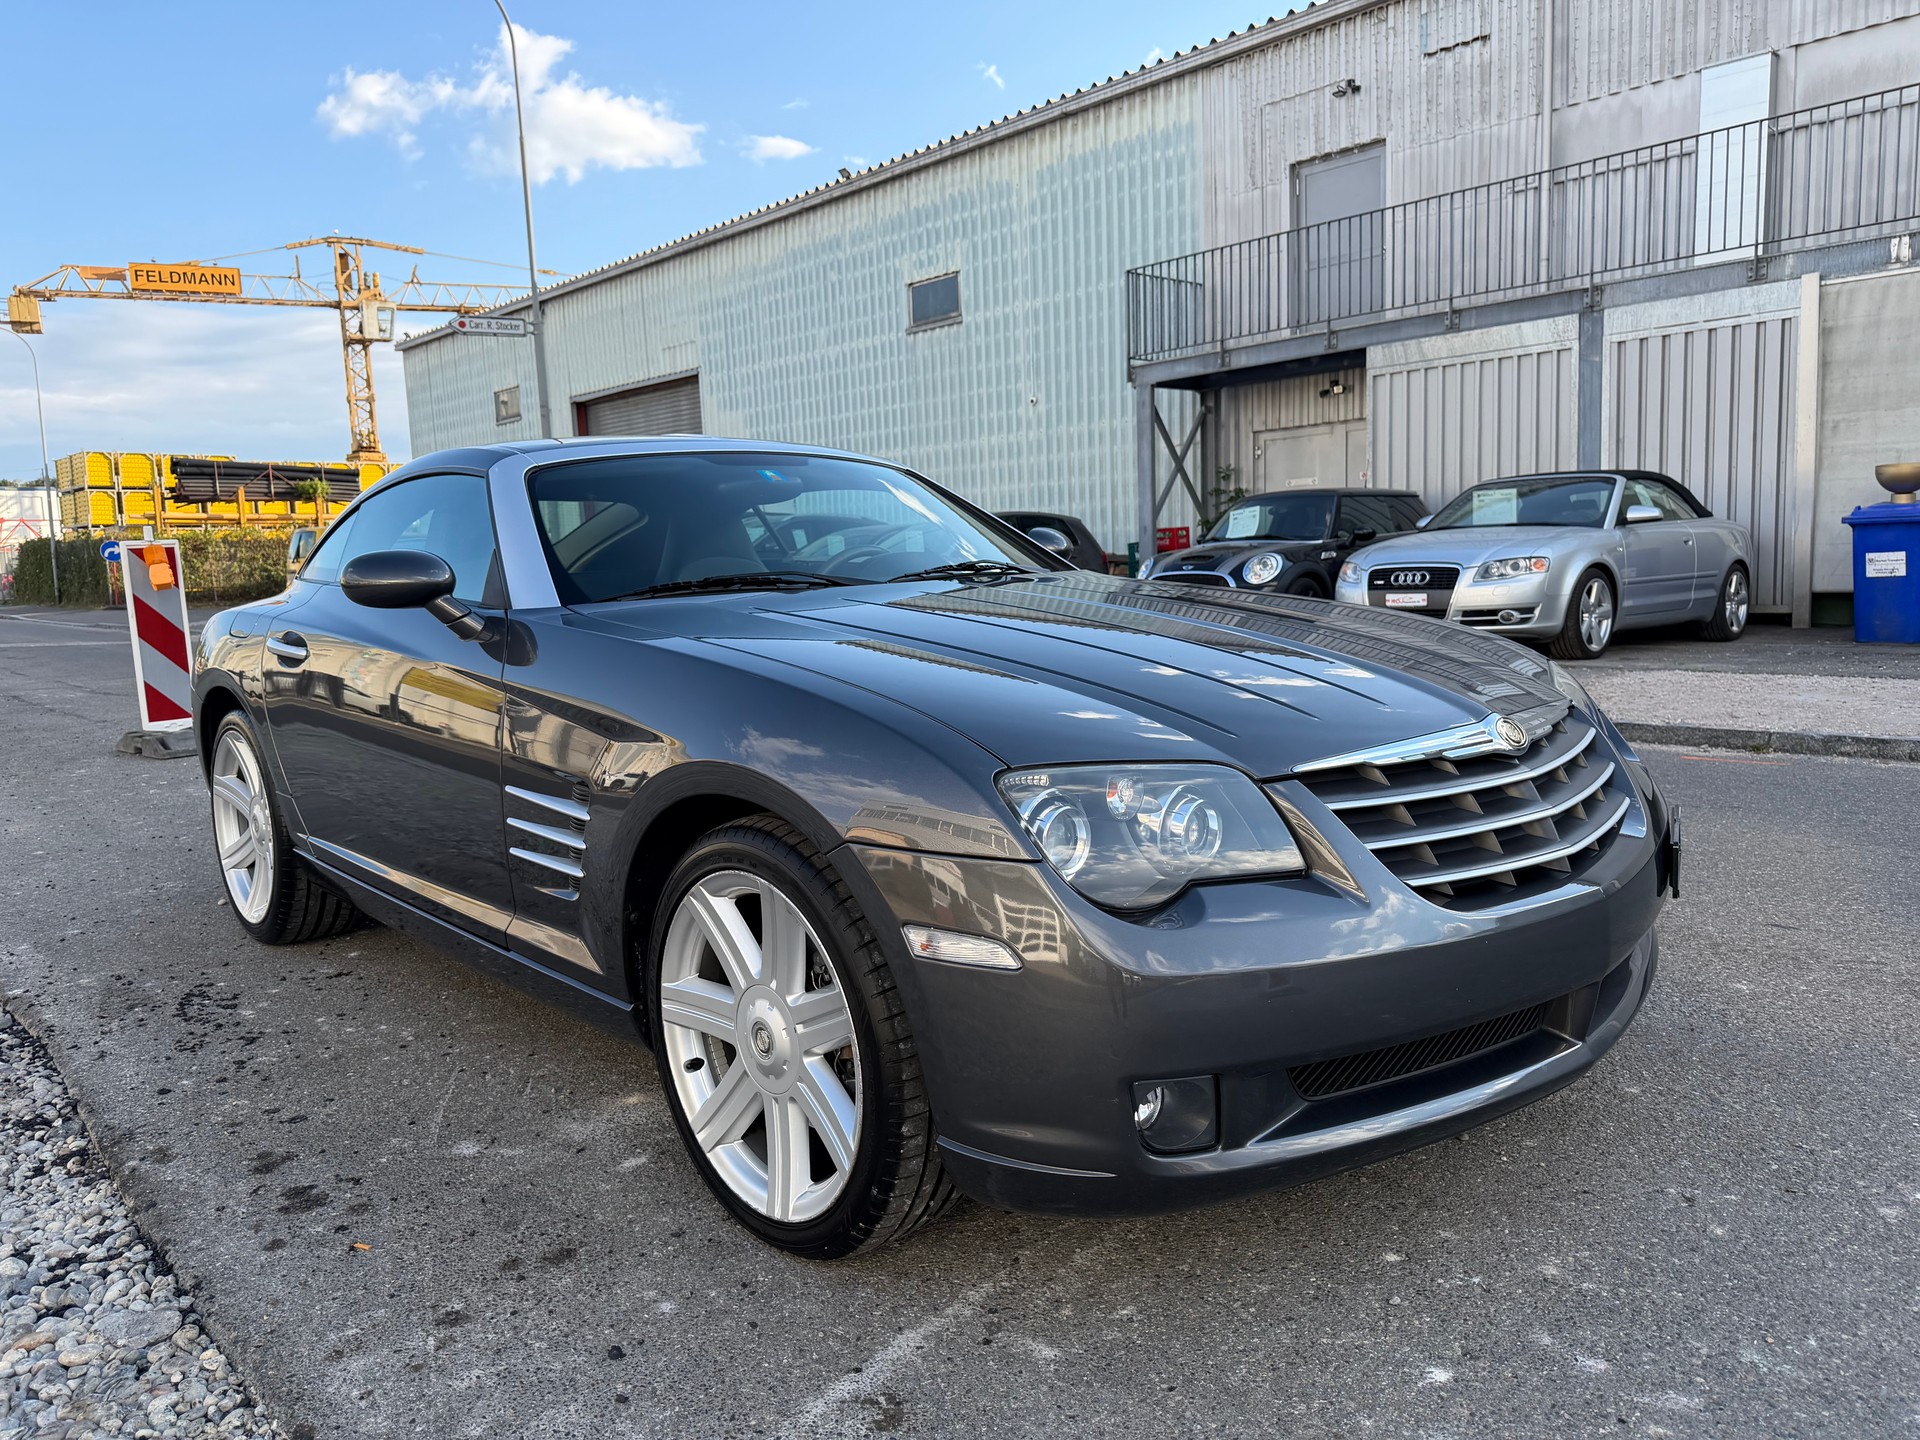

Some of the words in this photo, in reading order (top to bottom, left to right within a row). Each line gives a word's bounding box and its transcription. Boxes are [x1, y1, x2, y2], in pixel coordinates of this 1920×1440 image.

[134, 269, 236, 286] FELDMANN
[469, 320, 486, 330] Carr.
[487, 320, 495, 330] R.
[496, 321, 521, 331] Stocker
